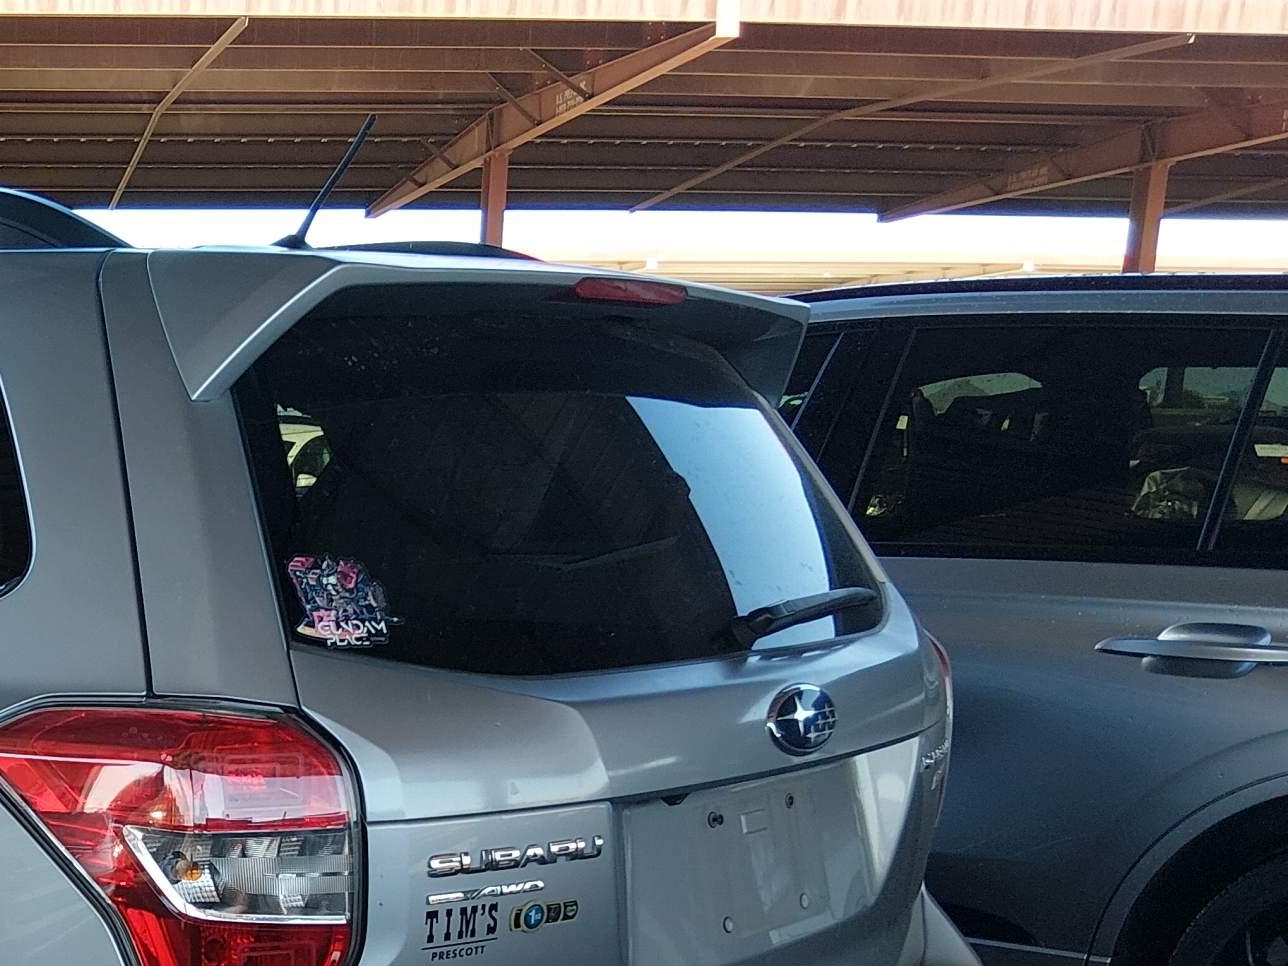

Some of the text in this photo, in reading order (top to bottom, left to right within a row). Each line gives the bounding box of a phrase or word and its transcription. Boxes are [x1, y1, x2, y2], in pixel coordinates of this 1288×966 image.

[317, 620, 388, 636] GUNDAM
[326, 633, 371, 647] PLACE
[427, 834, 605, 878] SUBARU
[425, 901, 499, 944] TIM'S
[430, 945, 487, 962] PRESCOTT
